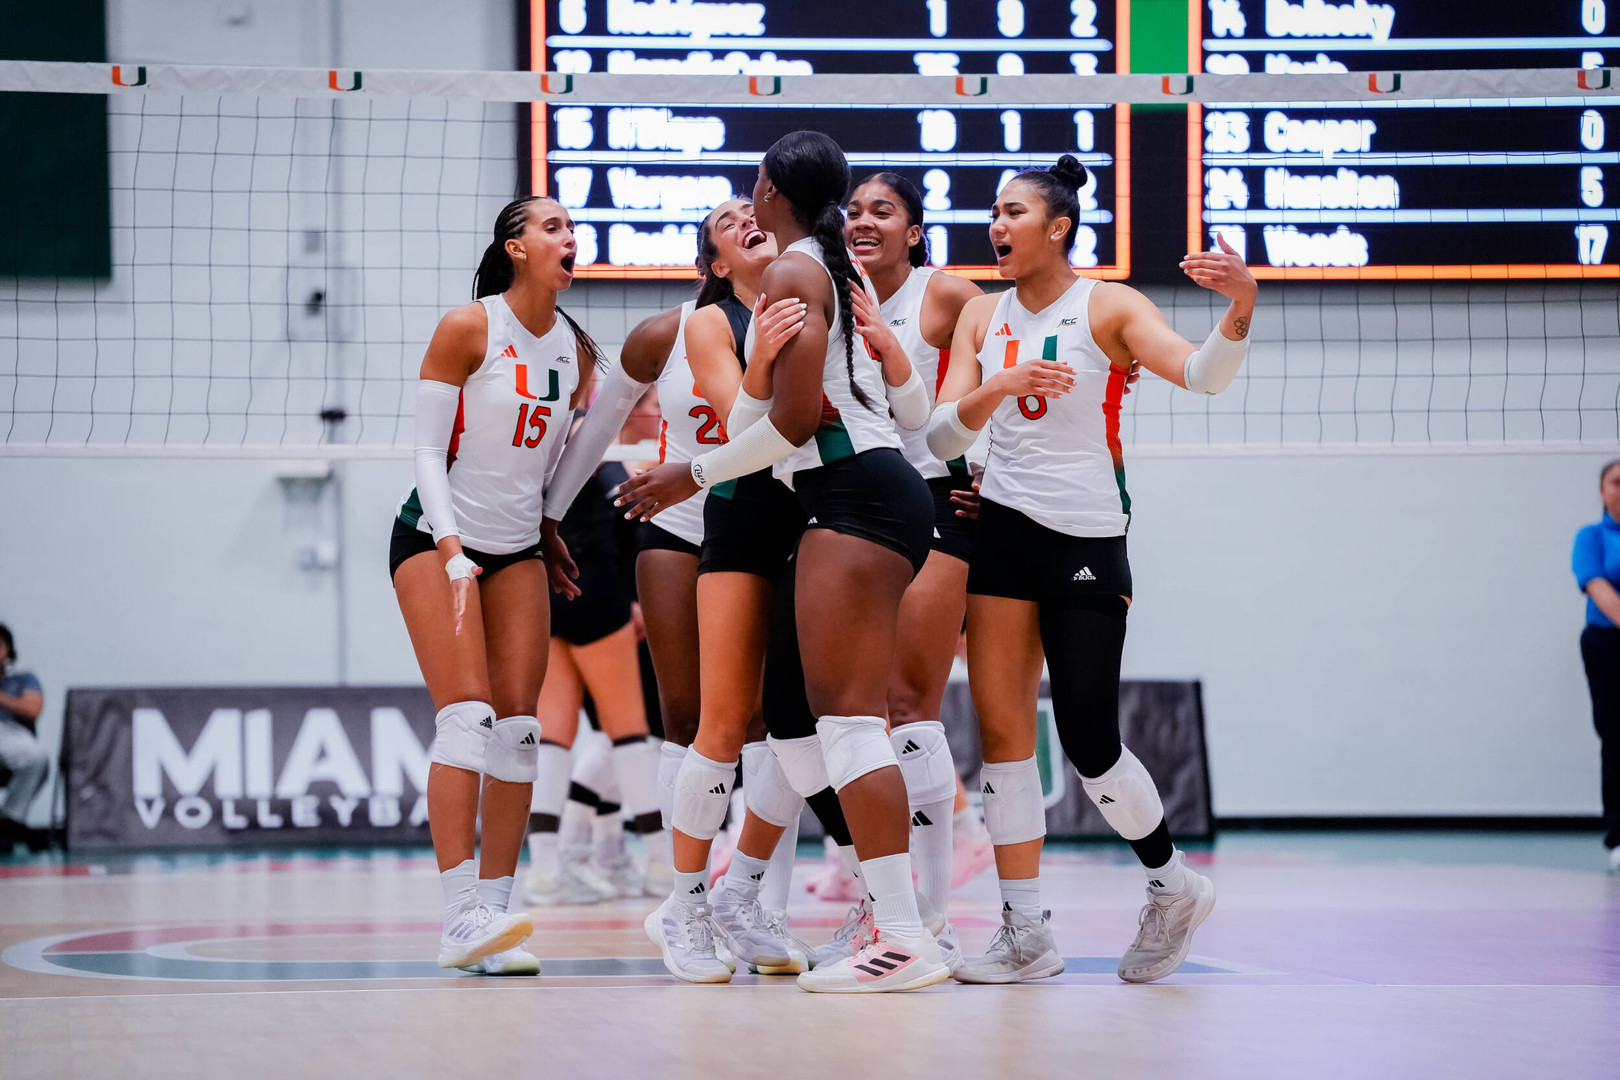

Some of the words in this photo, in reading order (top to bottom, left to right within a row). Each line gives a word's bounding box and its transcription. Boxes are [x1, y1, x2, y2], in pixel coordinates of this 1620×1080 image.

[1070, 0, 1098, 37] 2
[1582, 0, 1606, 35] 0
[1001, 110, 1021, 150] 1
[1074, 110, 1094, 150] 1
[1581, 110, 1605, 150] 0
[923, 168, 951, 211] 2
[1581, 166, 1604, 208] 5
[927, 225, 948, 267] 1
[1574, 224, 1608, 265] 17
[890, 318, 907, 326] ACC
[1058, 318, 1077, 326] ACC
[556, 355, 570, 364] ACC
[515, 364, 560, 402] U
[512, 403, 551, 449] 15
[132, 708, 435, 799] MIAM
[134, 796, 429, 829] VOLLEYB
